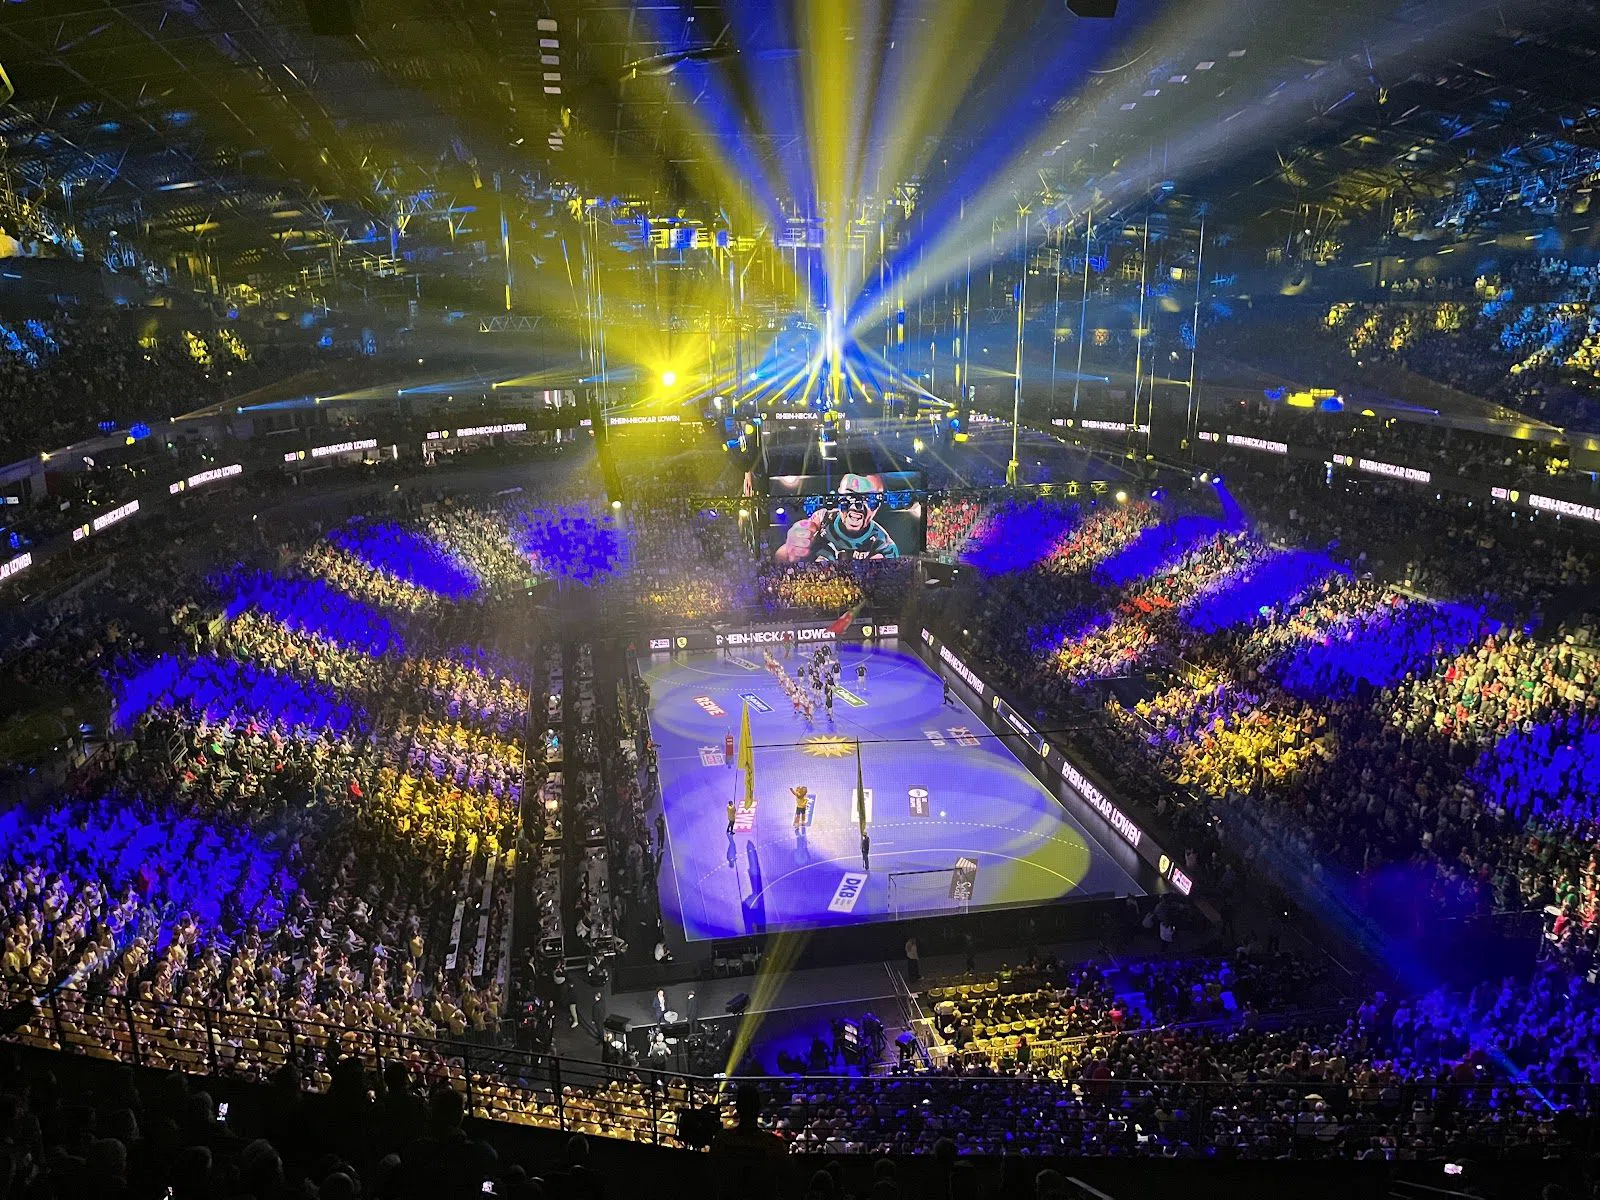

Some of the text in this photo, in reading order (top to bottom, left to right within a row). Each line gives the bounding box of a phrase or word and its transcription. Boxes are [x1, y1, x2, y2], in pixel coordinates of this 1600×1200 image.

[694, 696, 725, 716] REWE
[1062, 761, 1113, 819] RHEIN-NECKAR
[839, 878, 862, 897] DKB
